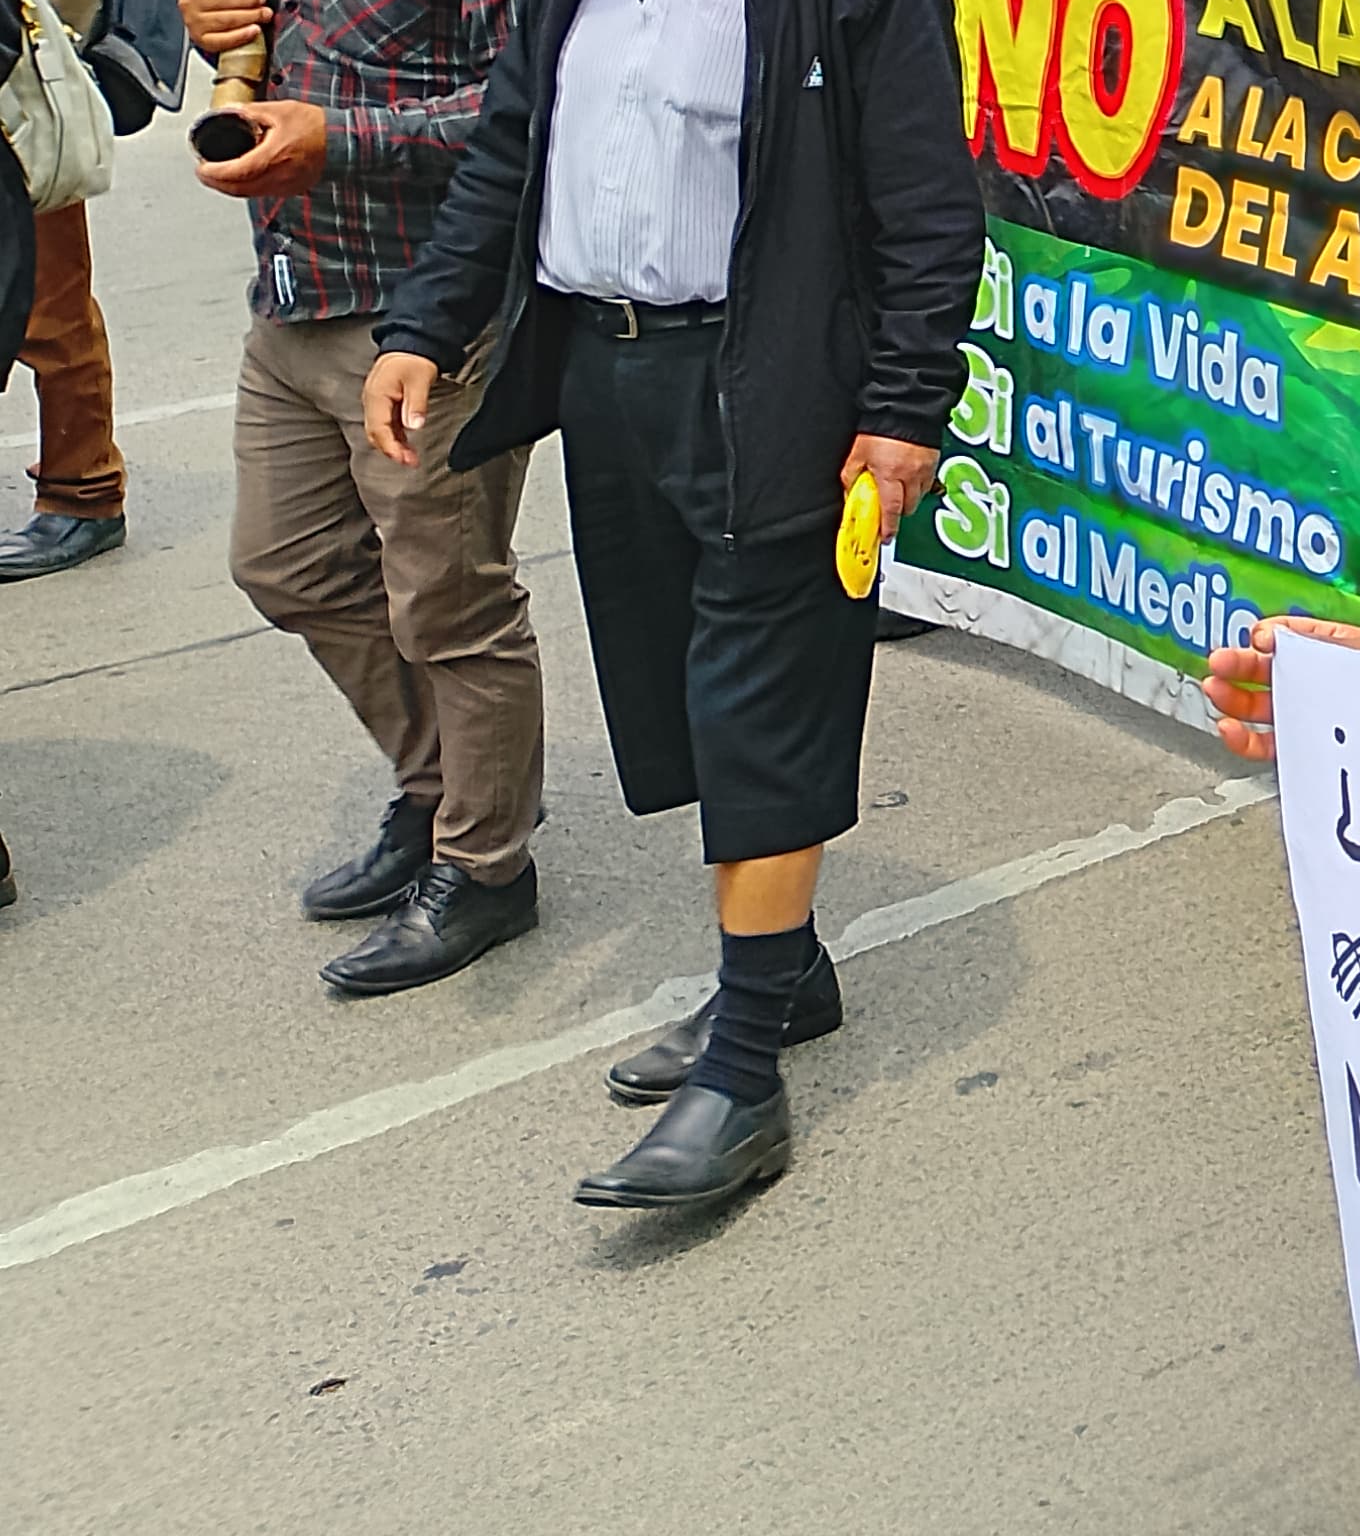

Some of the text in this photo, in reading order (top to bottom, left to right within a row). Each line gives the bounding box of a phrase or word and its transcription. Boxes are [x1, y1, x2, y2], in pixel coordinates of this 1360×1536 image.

[1177, 75, 1223, 149] A
[1236, 85, 1306, 170] LA
[1170, 165, 1295, 273] DEL
[1024, 282, 1058, 345] a
[1066, 280, 1131, 366] la
[1147, 304, 1281, 422] Vida
[1026, 399, 1075, 472] al
[1079, 411, 1344, 577] Turismo
[1022, 515, 1078, 587] al
